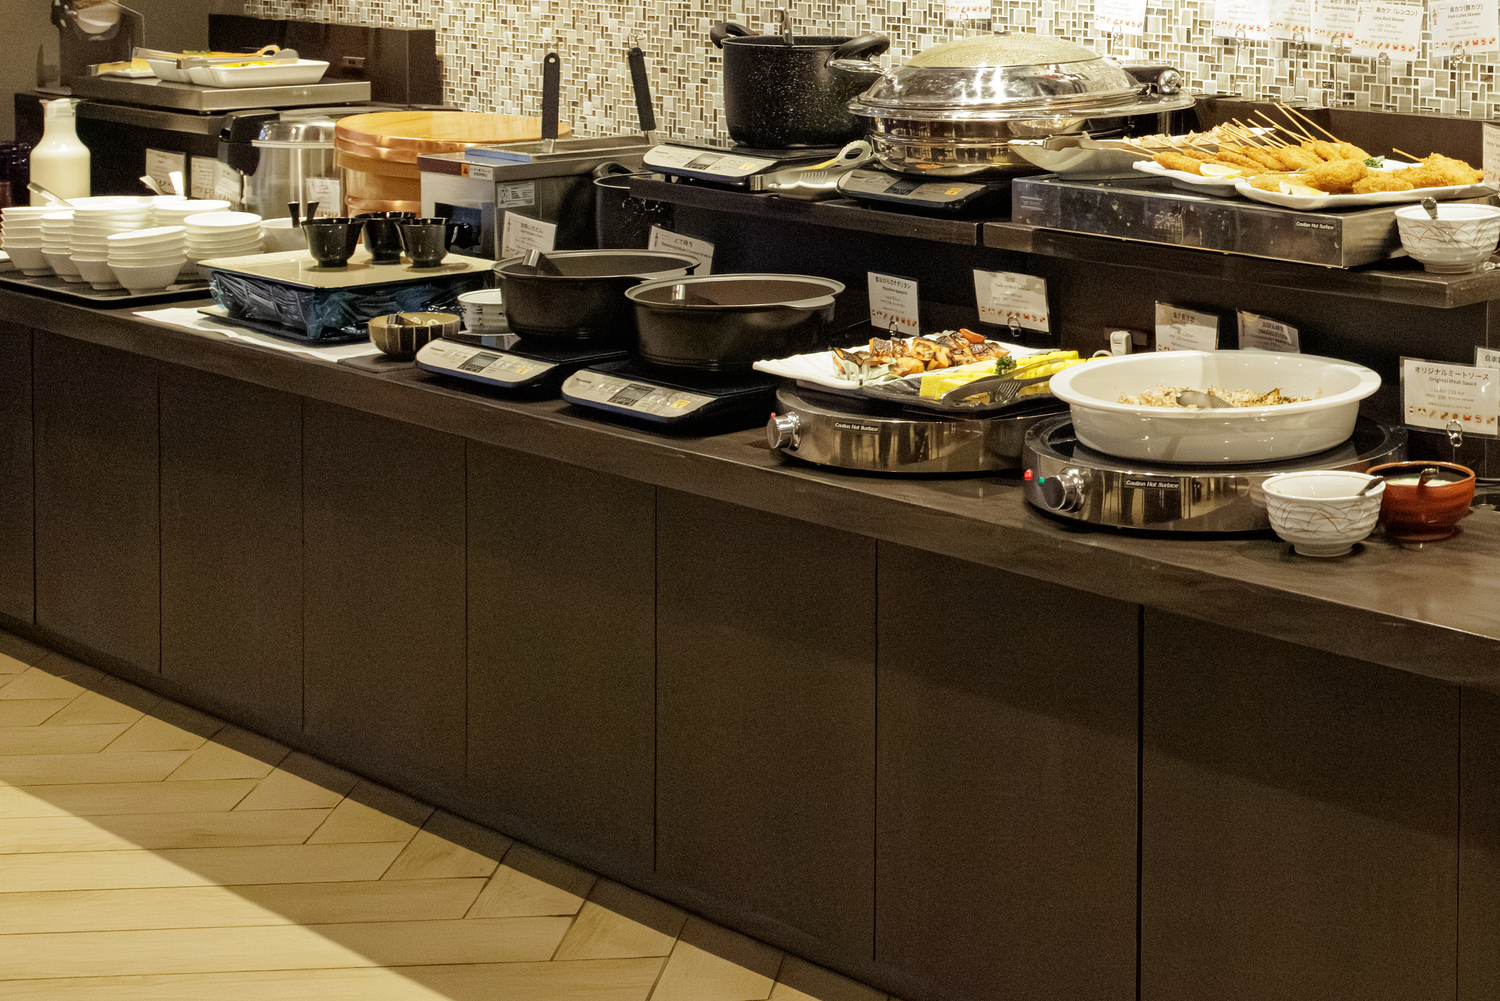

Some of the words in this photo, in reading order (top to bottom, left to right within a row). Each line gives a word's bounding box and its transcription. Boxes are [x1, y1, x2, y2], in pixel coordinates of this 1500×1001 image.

[1414, 366, 1489, 381] オリジナルミートソース
[1428, 376, 1449, 384] Original
